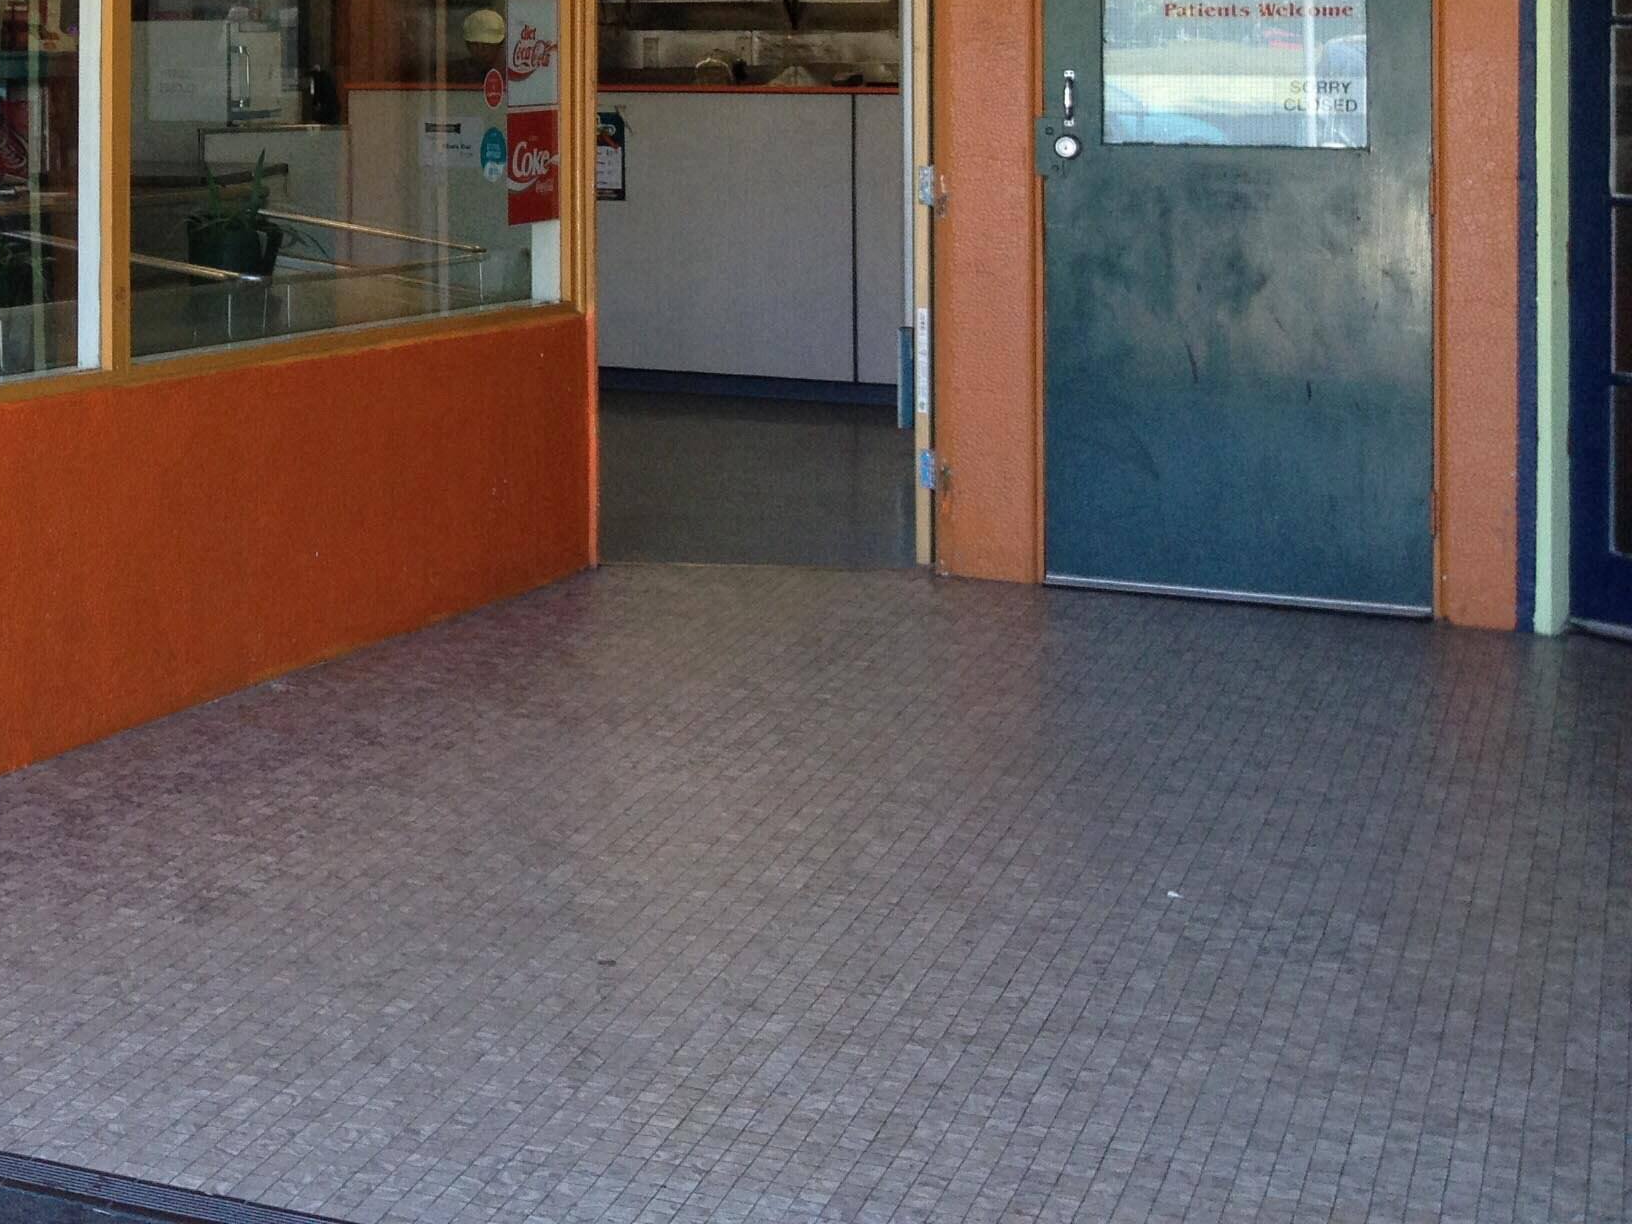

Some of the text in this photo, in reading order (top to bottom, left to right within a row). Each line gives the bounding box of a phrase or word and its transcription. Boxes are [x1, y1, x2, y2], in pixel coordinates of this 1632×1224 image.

[1164, 2, 1251, 19] Patients
[1283, 98, 1359, 113] CLSED
[512, 140, 551, 179] Coke
